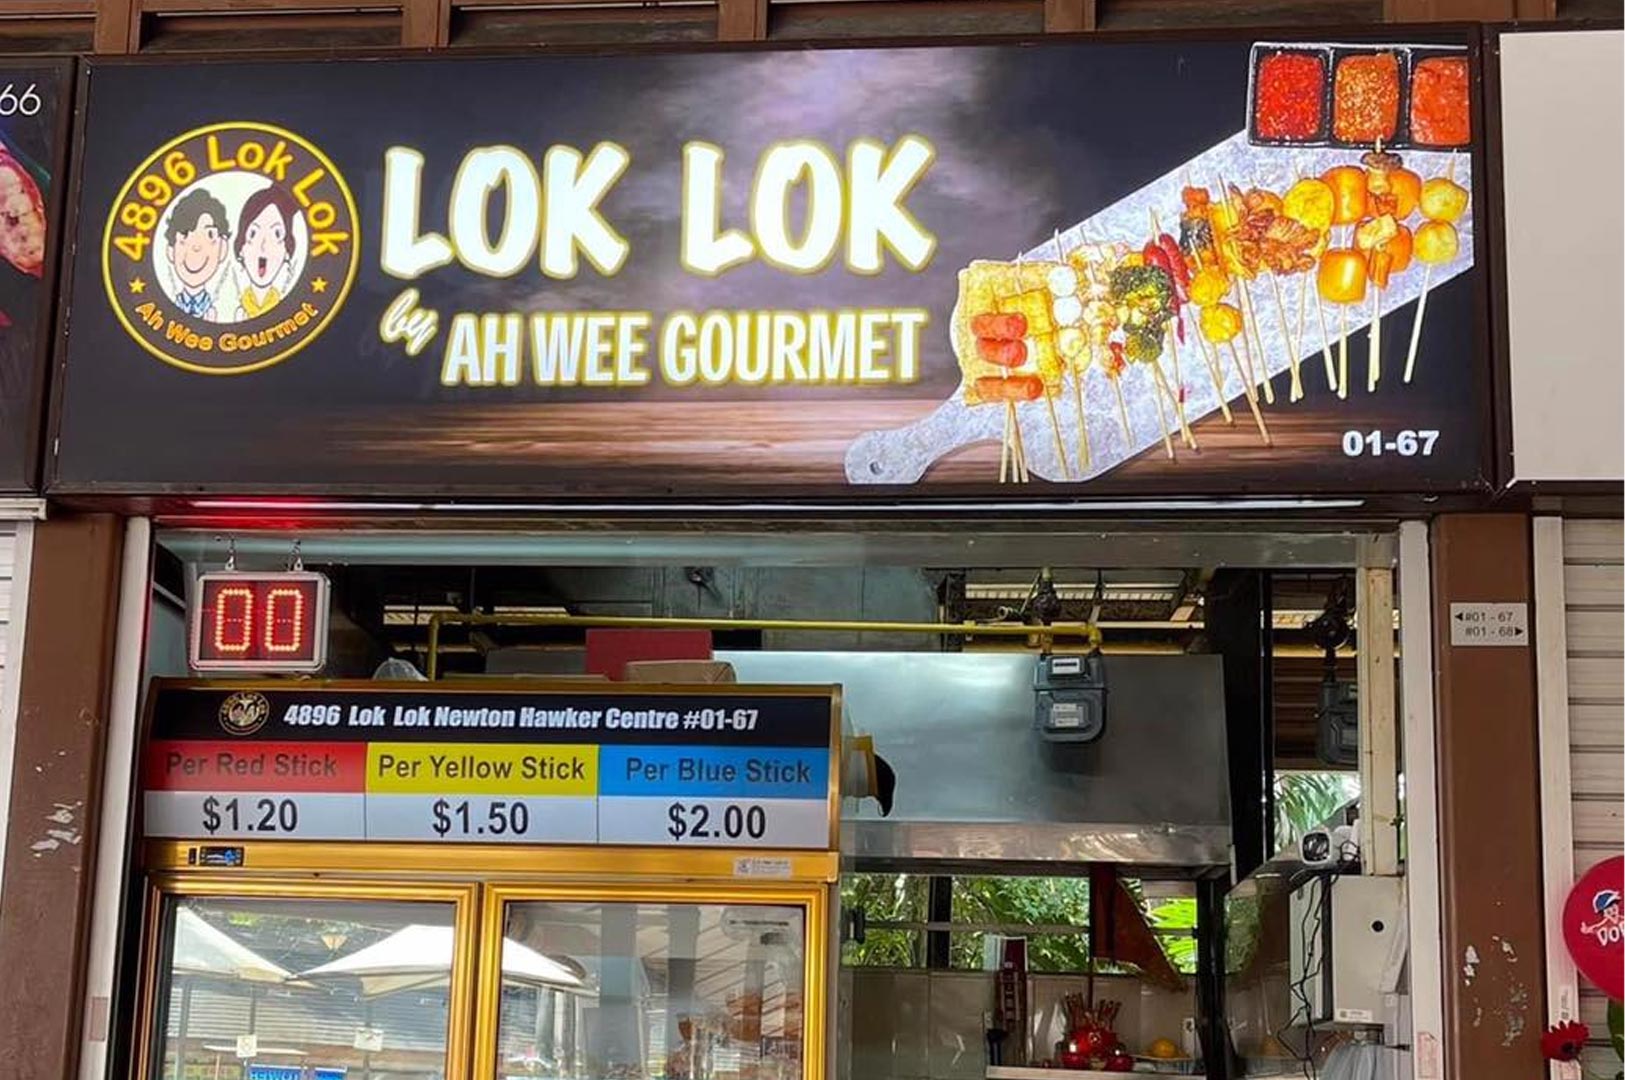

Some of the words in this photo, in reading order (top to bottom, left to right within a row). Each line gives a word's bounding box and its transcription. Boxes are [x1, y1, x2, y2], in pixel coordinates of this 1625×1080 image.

[113, 150, 197, 262] 4896
[206, 135, 294, 181] Lok
[292, 168, 349, 257] Lok
[381, 140, 630, 280] LOK
[681, 134, 937, 277] LOK
[135, 301, 164, 330] Ah
[165, 318, 214, 351] Wee
[218, 301, 319, 352] Gourmet
[380, 286, 440, 356] by
[441, 312, 523, 386] AH
[530, 311, 650, 386] WEE
[660, 308, 929, 385] GOURMET
[1341, 429, 1440, 456] 01-67
[215, 588, 303, 652] 00
[283, 704, 341, 726] 4896
[348, 705, 386, 727] Lok
[393, 706, 432, 727] Lok
[433, 706, 516, 728] Newton
[519, 707, 602, 729] Hawker
[605, 708, 679, 730] Centre
[682, 708, 759, 731] #01-67
[166, 753, 207, 776] Per
[216, 753, 265, 776] Red
[274, 752, 337, 776] Stick
[378, 754, 422, 778] Per
[429, 755, 513, 779] Yellow
[521, 756, 586, 781] Stick
[626, 757, 668, 781] Per
[678, 757, 737, 783] Blue
[745, 758, 811, 784] Stick
[202, 796, 298, 835] $1.20
[432, 798, 529, 838] $1.50
[667, 802, 766, 841] $2.00
